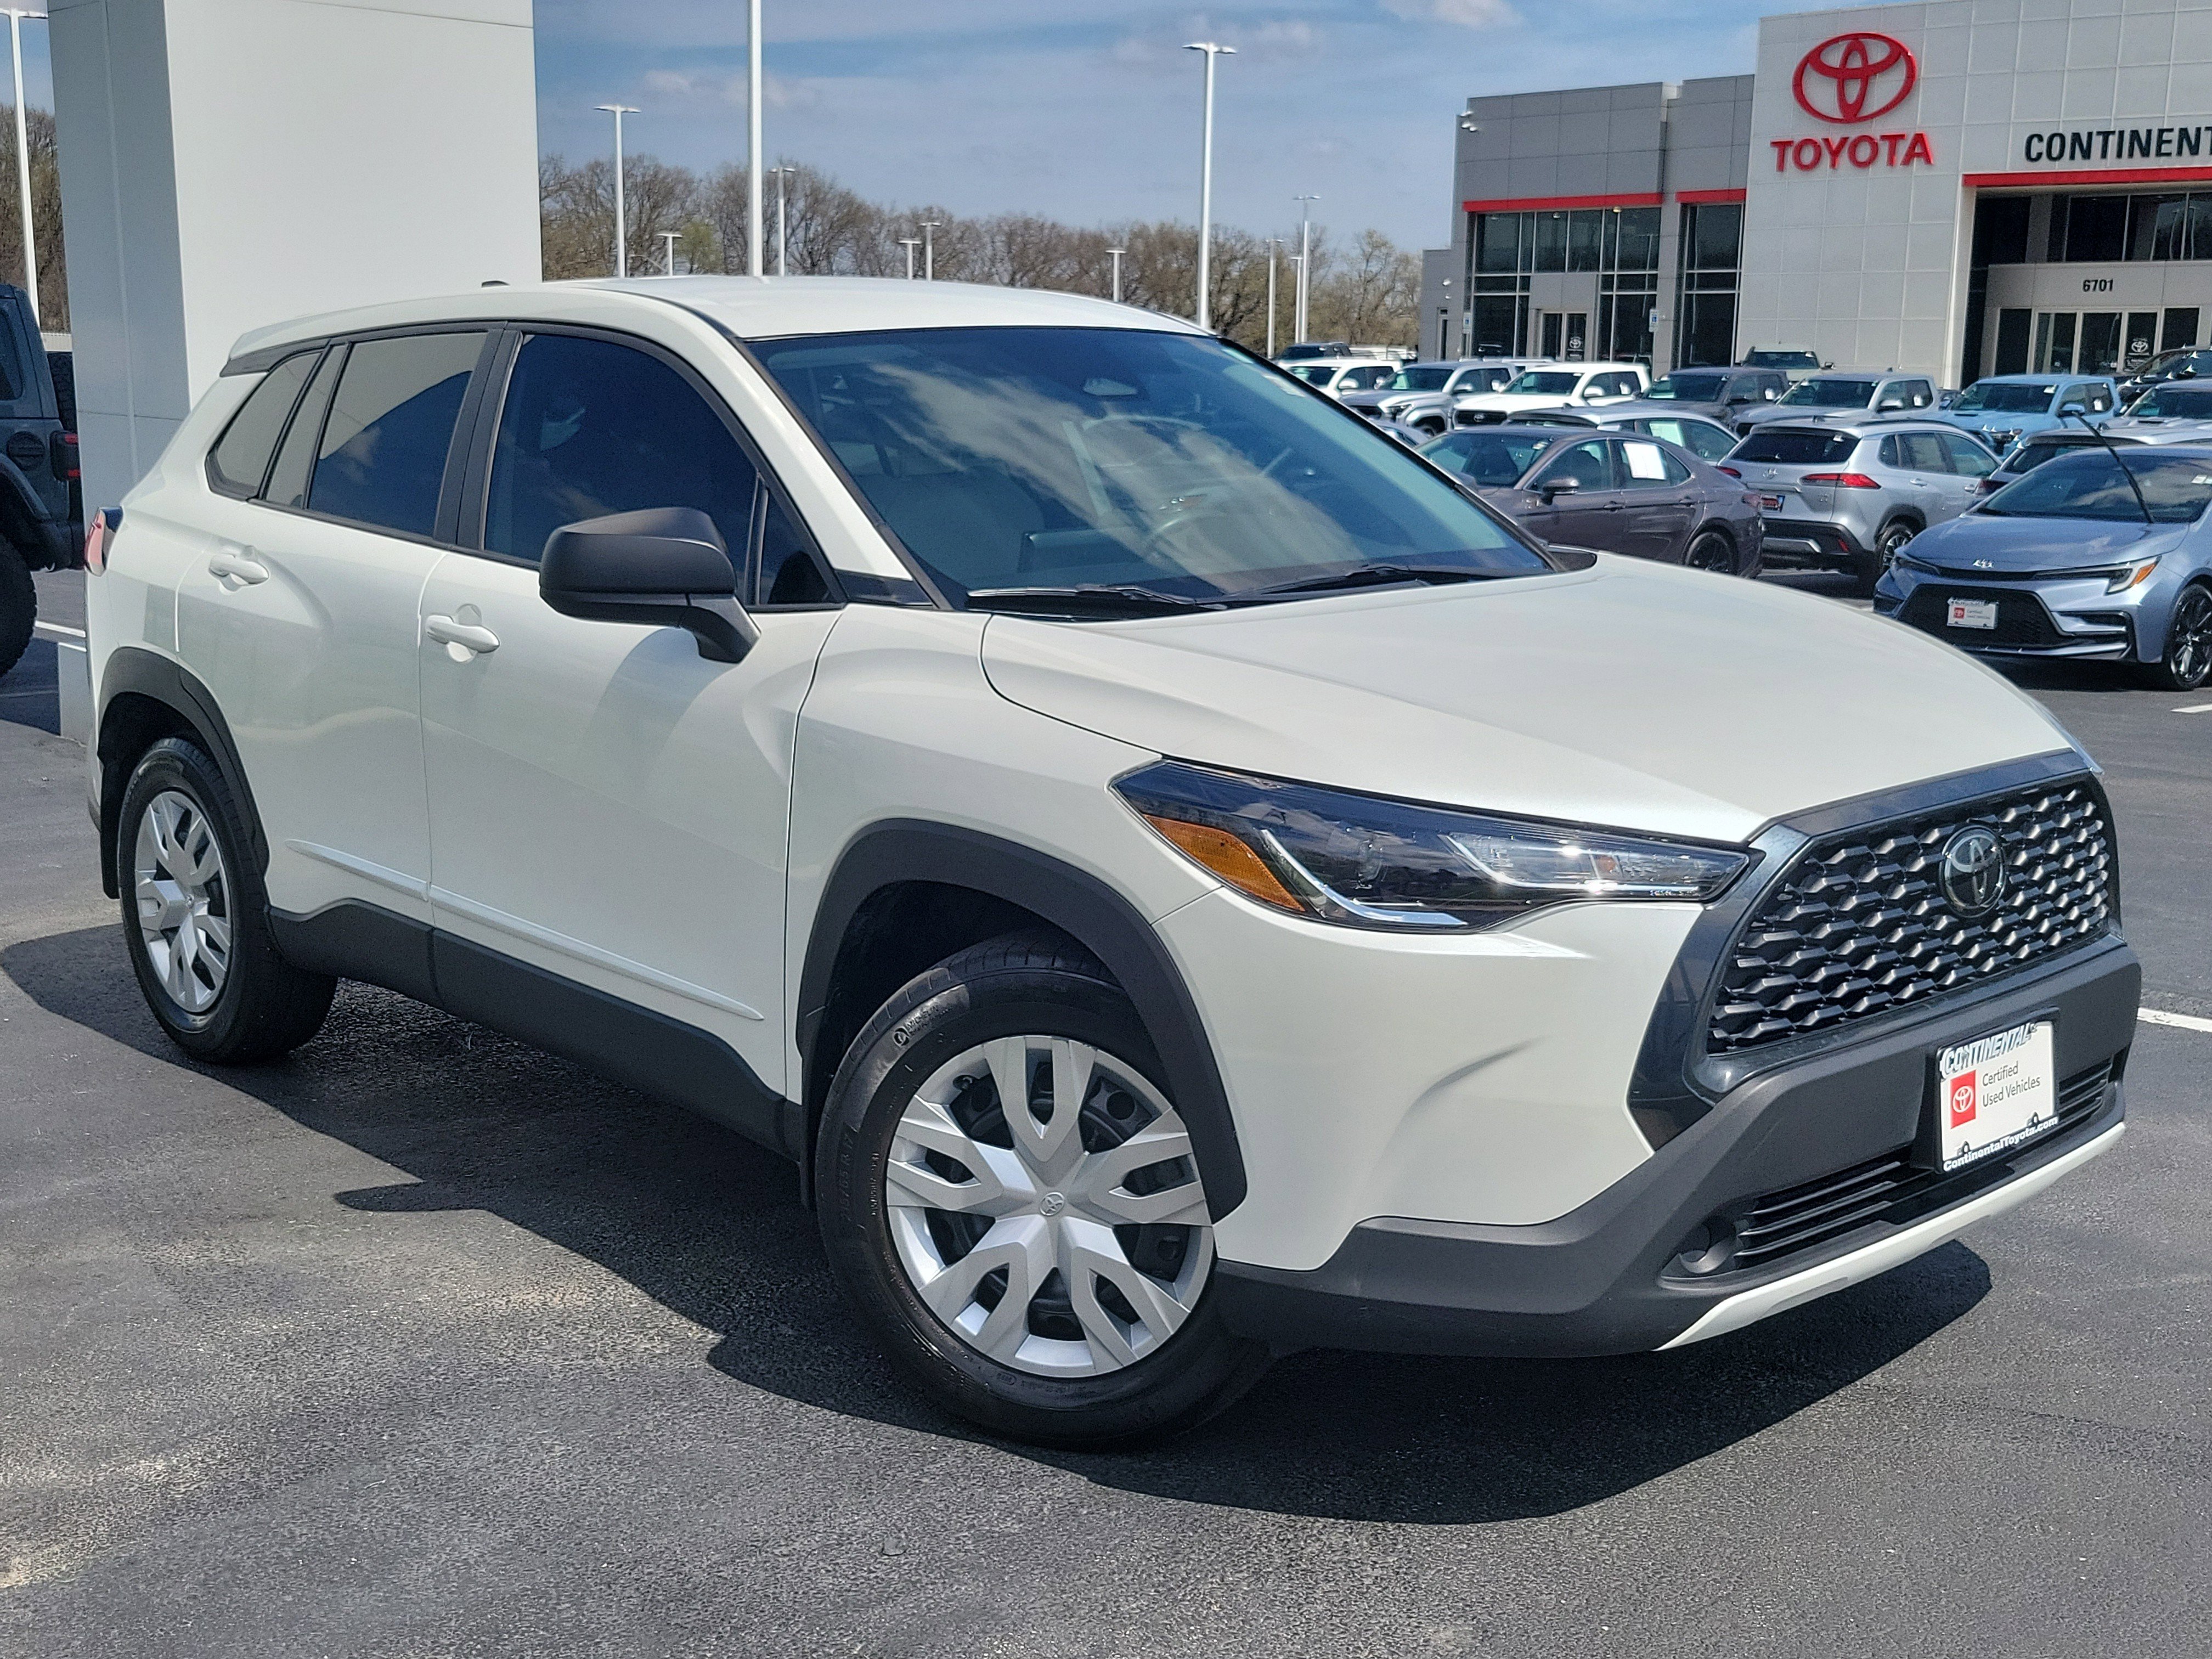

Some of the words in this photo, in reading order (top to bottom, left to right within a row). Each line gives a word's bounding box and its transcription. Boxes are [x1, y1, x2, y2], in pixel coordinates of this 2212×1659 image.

[1770, 133, 1933, 172] TOYOTA
[2083, 279, 2113, 292] 6701
[1944, 1022, 2033, 1075] CONTINENTAL
[1982, 1060, 2018, 1087] Certified
[1982, 1086, 2004, 1107] Used
[2005, 1076, 2041, 1098] Vehicles
[1943, 1116, 2058, 1172] ContinentalToyota.com
